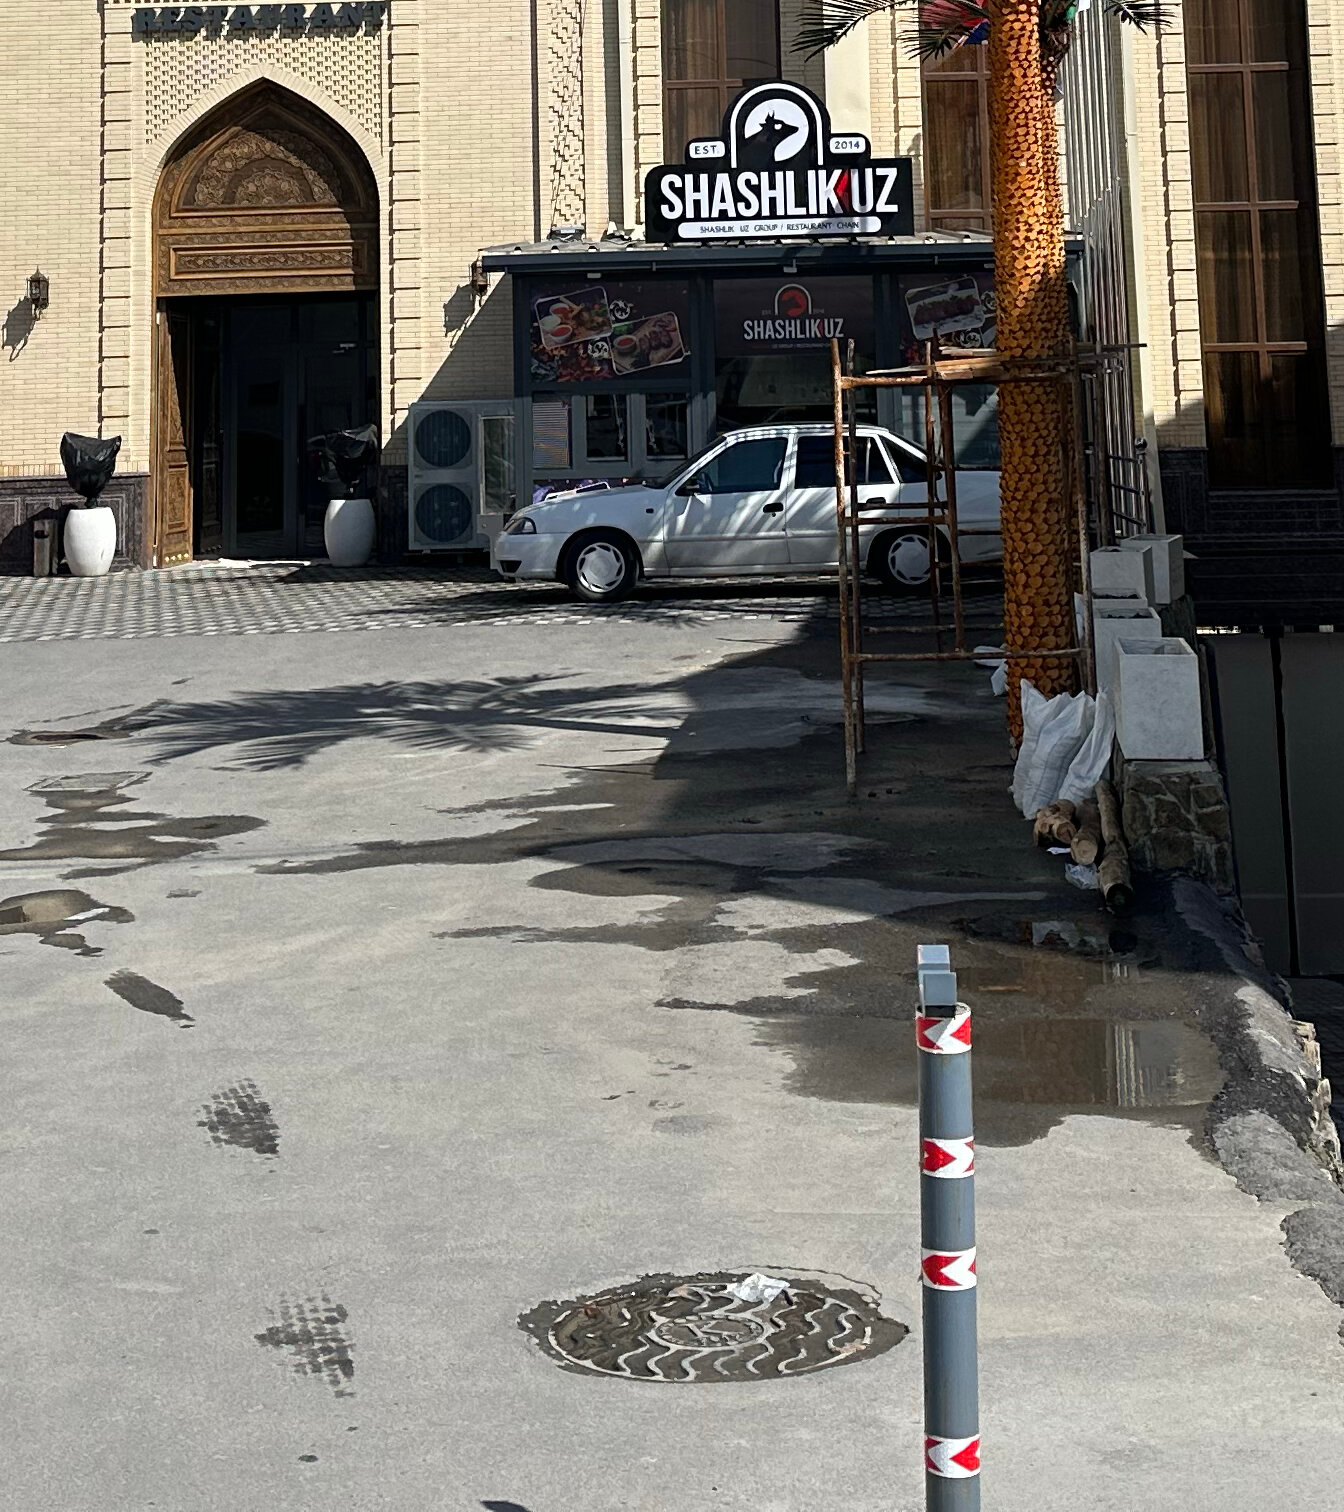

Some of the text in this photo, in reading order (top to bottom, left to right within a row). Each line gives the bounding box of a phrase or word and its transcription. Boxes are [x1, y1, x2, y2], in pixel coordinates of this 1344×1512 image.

[133, 1, 387, 33] RESTAURANT
[834, 140, 860, 150] 2014
[787, 221, 832, 231] RESTAURANT
[836, 220, 860, 229] CHAIN
